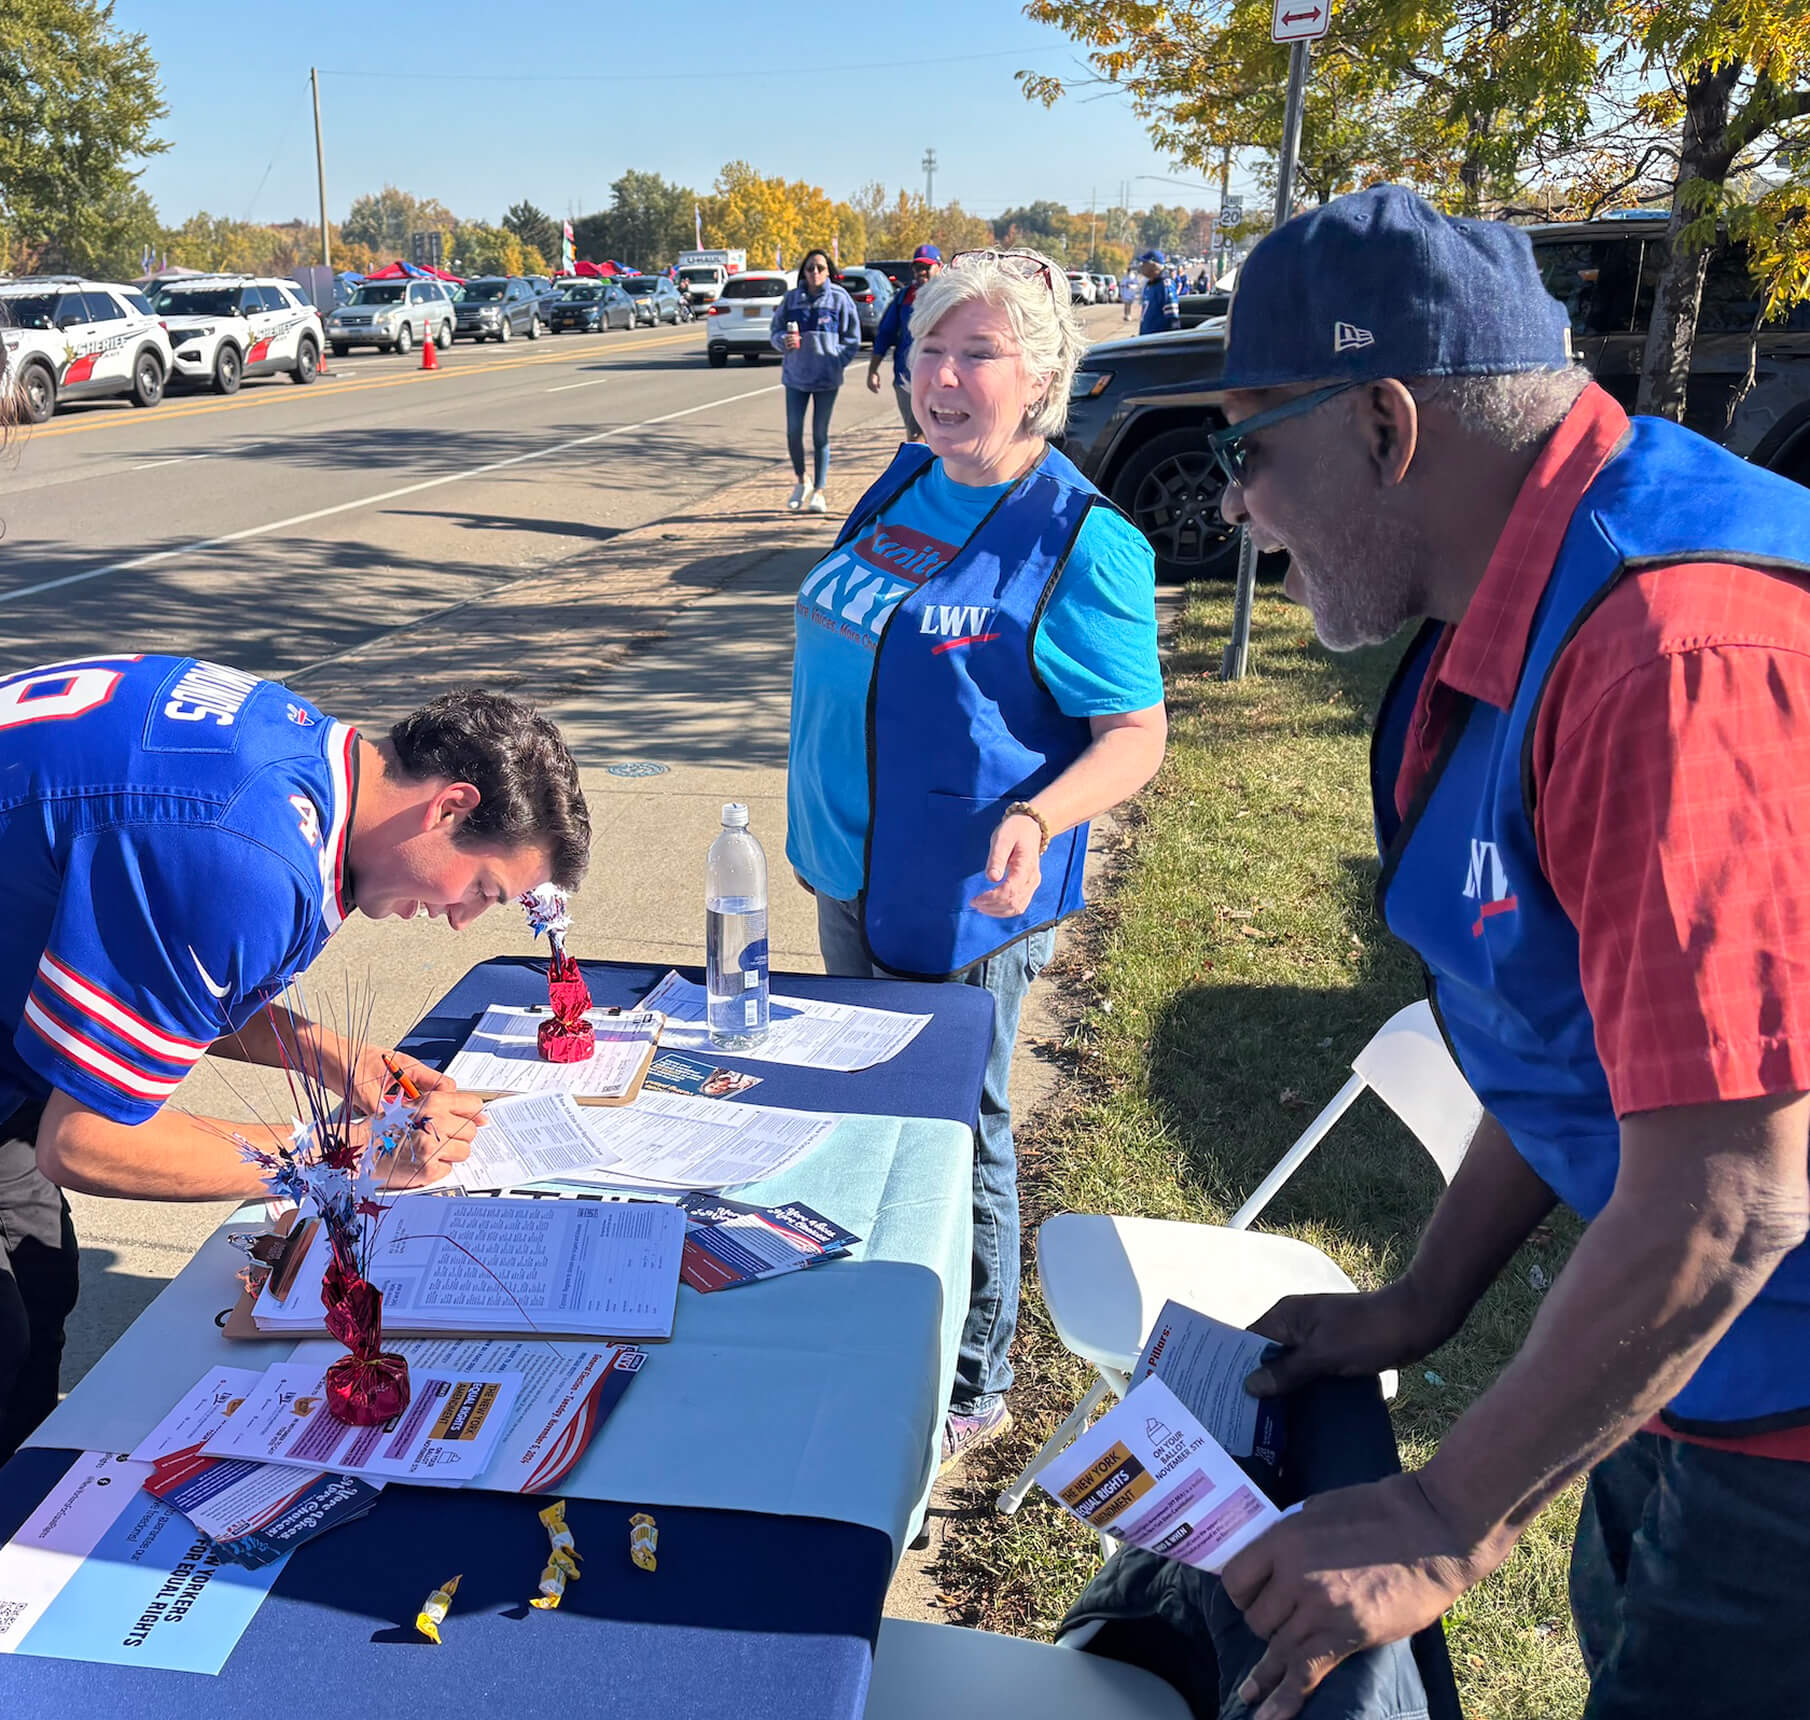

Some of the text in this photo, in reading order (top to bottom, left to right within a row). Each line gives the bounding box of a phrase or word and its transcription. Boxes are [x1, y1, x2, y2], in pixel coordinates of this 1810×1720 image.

[1222, 210, 1240, 223] 20
[75, 336, 128, 356] SHERIFF
[840, 623, 861, 644] More
[919, 604, 992, 637] LWV
[1148, 1324, 1173, 1368] Pillars:
[450, 1383, 483, 1432] EQUAL RIGHTS
[1153, 1430, 1184, 1459] ON YOUR
[1155, 1436, 1205, 1481] NOVEMBER 5TH
[1160, 1439, 1187, 1465] BALLOT
[316, 1474, 354, 1501] More
[1062, 1451, 1120, 1502] THE NEW YORK
[1096, 1469, 1130, 1501] RIGHTS
[322, 1486, 358, 1511] More
[277, 1510, 325, 1540] Voices.
[123, 1538, 208, 1647] FOR EQUAL RIGHTS
[163, 1568, 216, 1623] YORKERS
